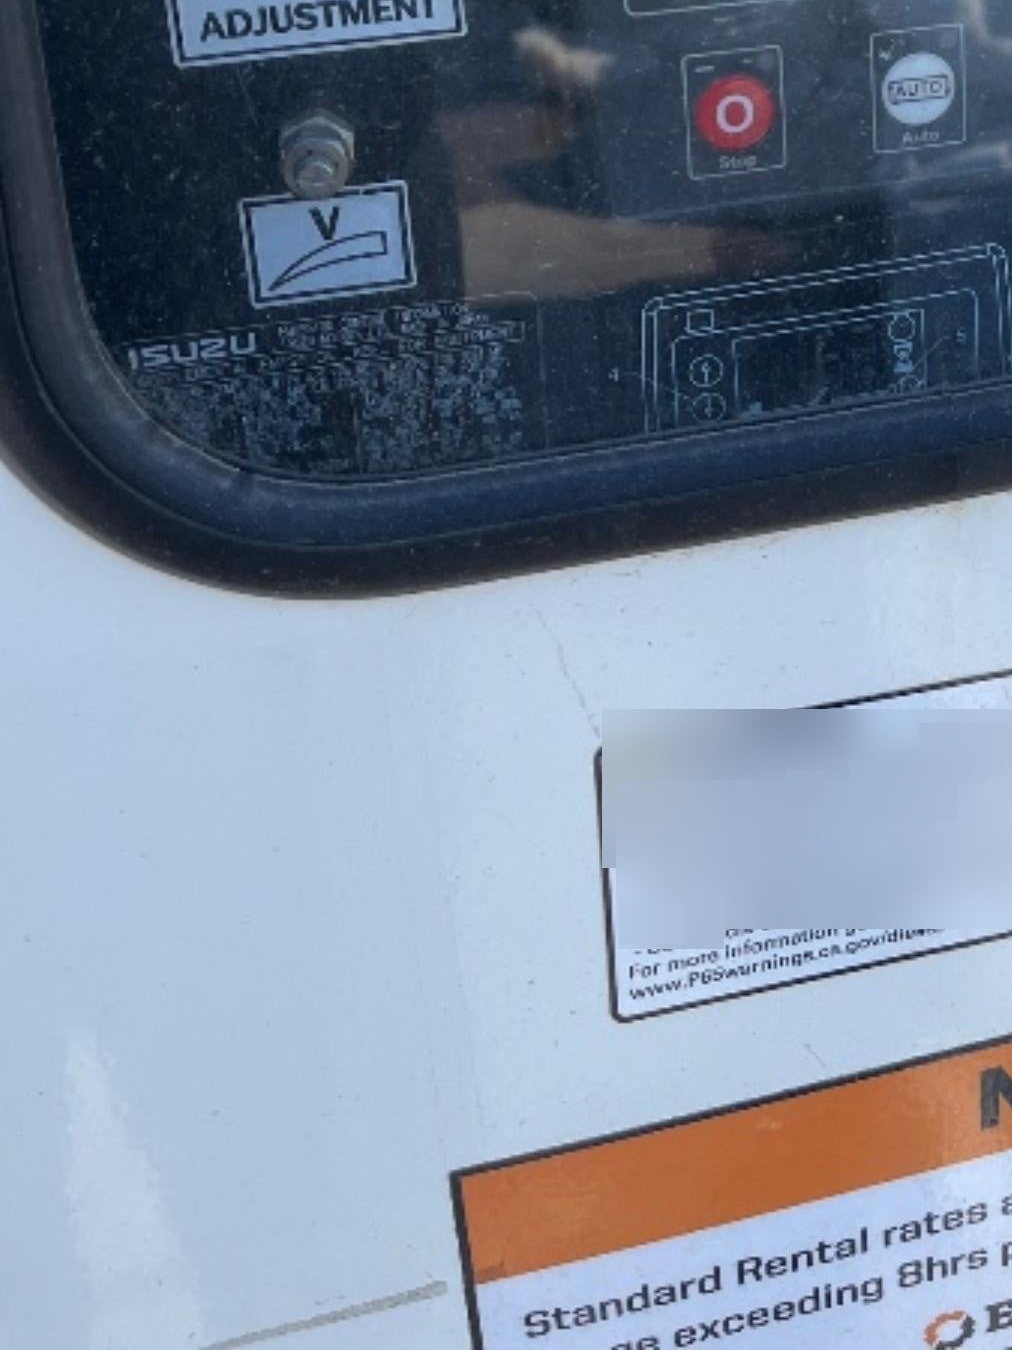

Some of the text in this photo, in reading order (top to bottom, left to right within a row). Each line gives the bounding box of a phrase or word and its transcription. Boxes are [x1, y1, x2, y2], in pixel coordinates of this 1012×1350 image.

[309, 206, 340, 241] V
[127, 332, 257, 371] ISUZU
[628, 961, 662, 980] For
[668, 951, 721, 972] more
[523, 1265, 722, 1339] Standard
[737, 1227, 869, 1286] Rental
[882, 1188, 989, 1249] rates
[673, 1270, 885, 1345] exceeding
[897, 1245, 989, 1289] 8hrs
